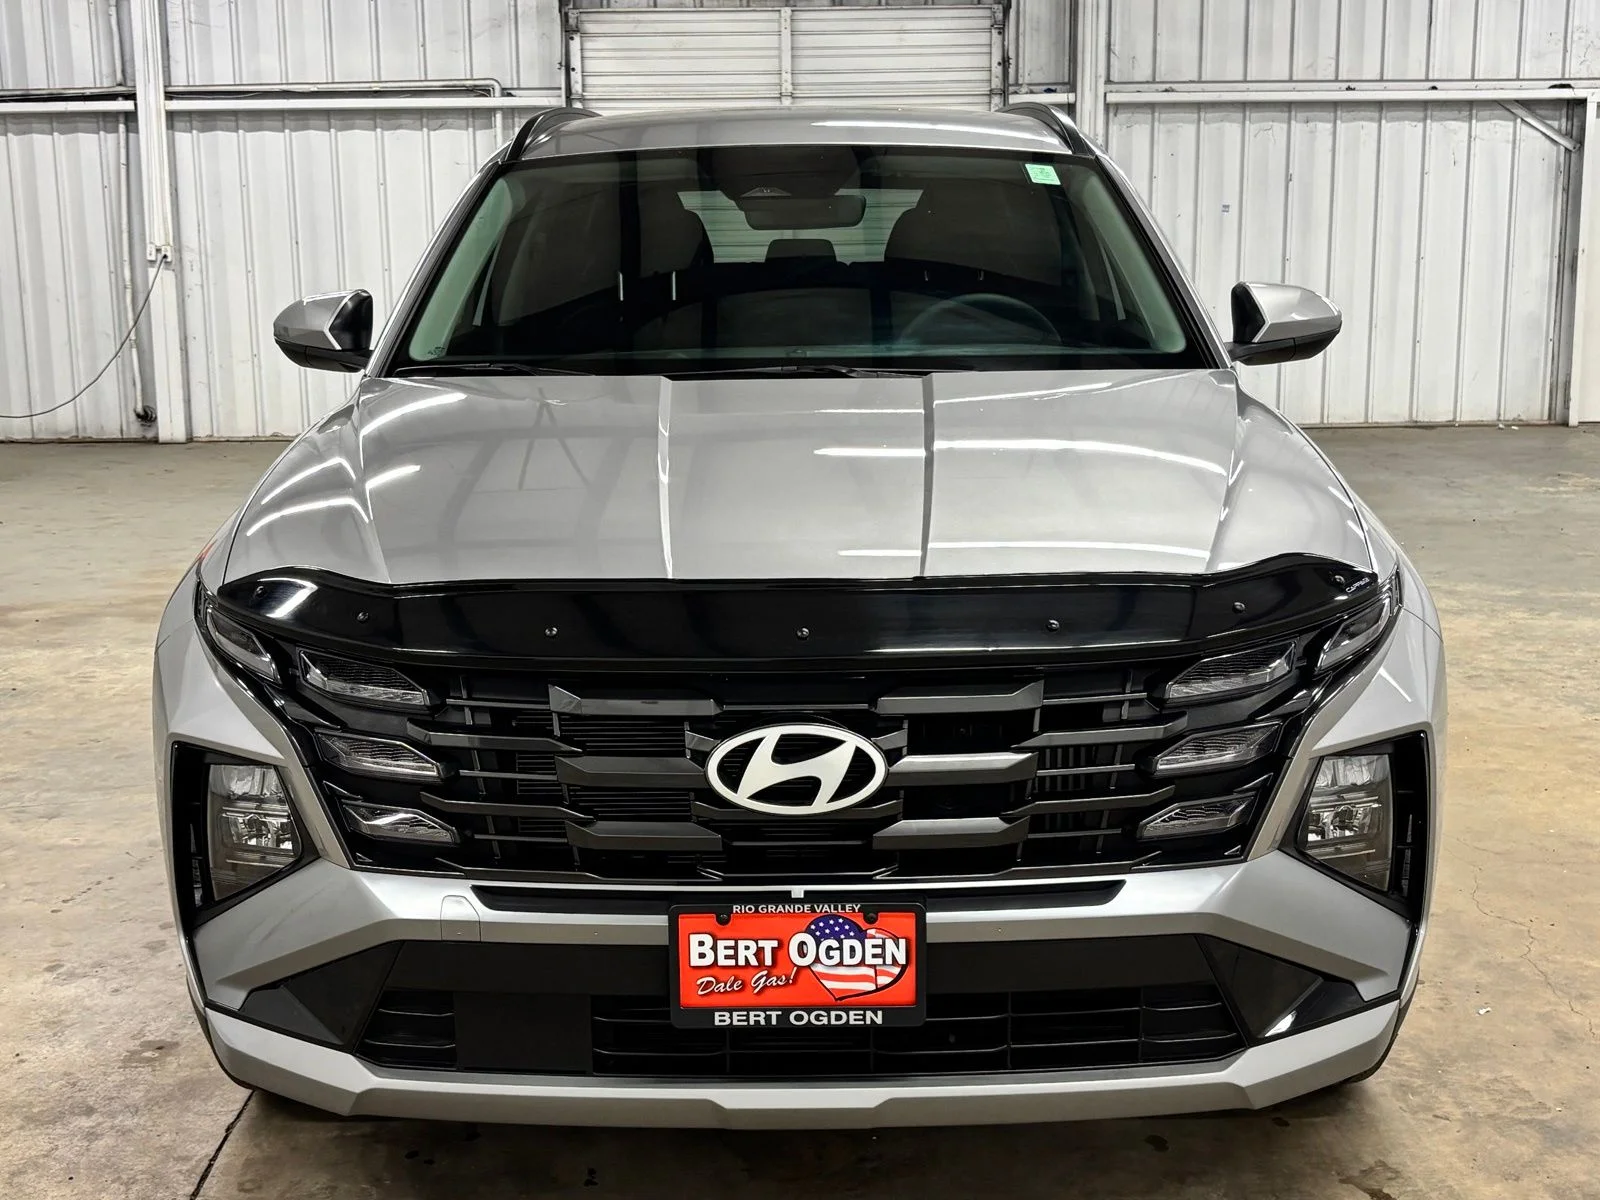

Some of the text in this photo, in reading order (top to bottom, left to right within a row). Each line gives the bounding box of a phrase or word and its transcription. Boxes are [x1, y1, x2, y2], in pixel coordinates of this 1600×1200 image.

[732, 903, 861, 914] RIO GRANDE VALLEY
[689, 932, 907, 967] BERT OGDEN
[696, 966, 798, 995] Dale Gas!
[714, 1010, 883, 1026] BERT OGDEN
